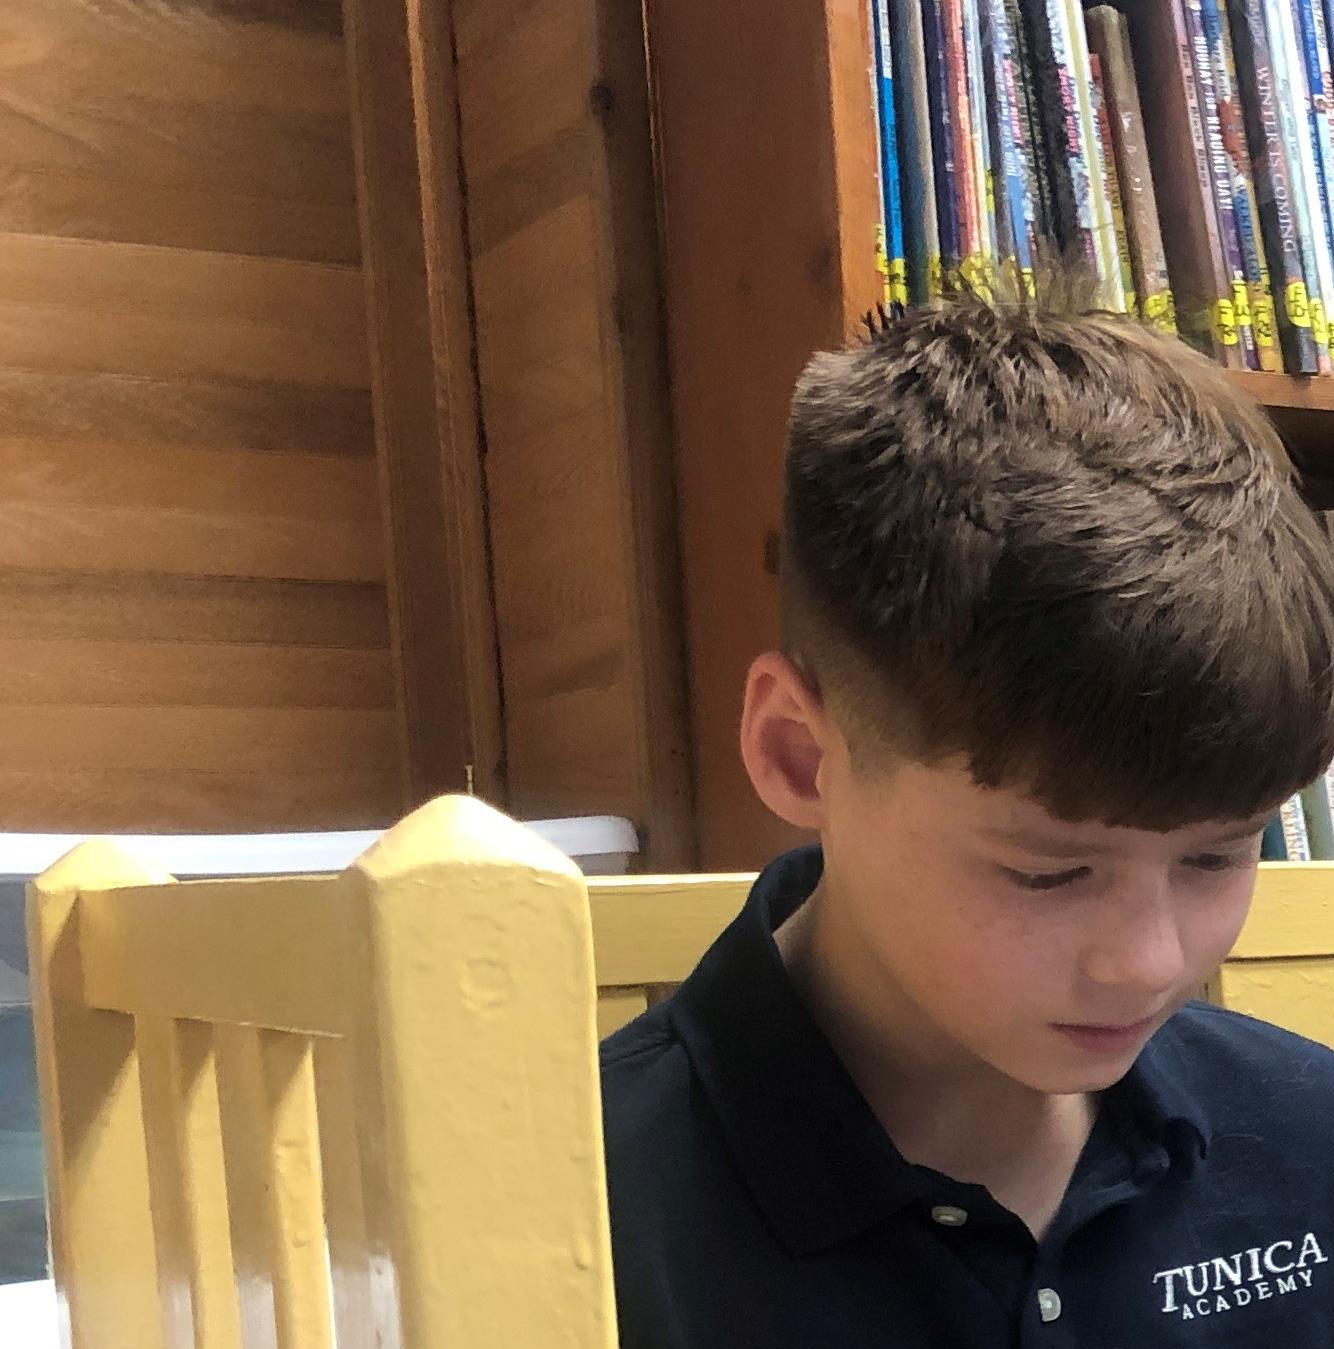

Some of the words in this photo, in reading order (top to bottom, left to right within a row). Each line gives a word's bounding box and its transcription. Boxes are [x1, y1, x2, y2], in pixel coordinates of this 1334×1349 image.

[1256, 66, 1279, 145] WINTER
[1268, 150, 1282, 167] IS
[1271, 175, 1297, 252] COMING
[1152, 1232, 1329, 1313] TUNICA
[1182, 1269, 1314, 1320] ACADEMY
